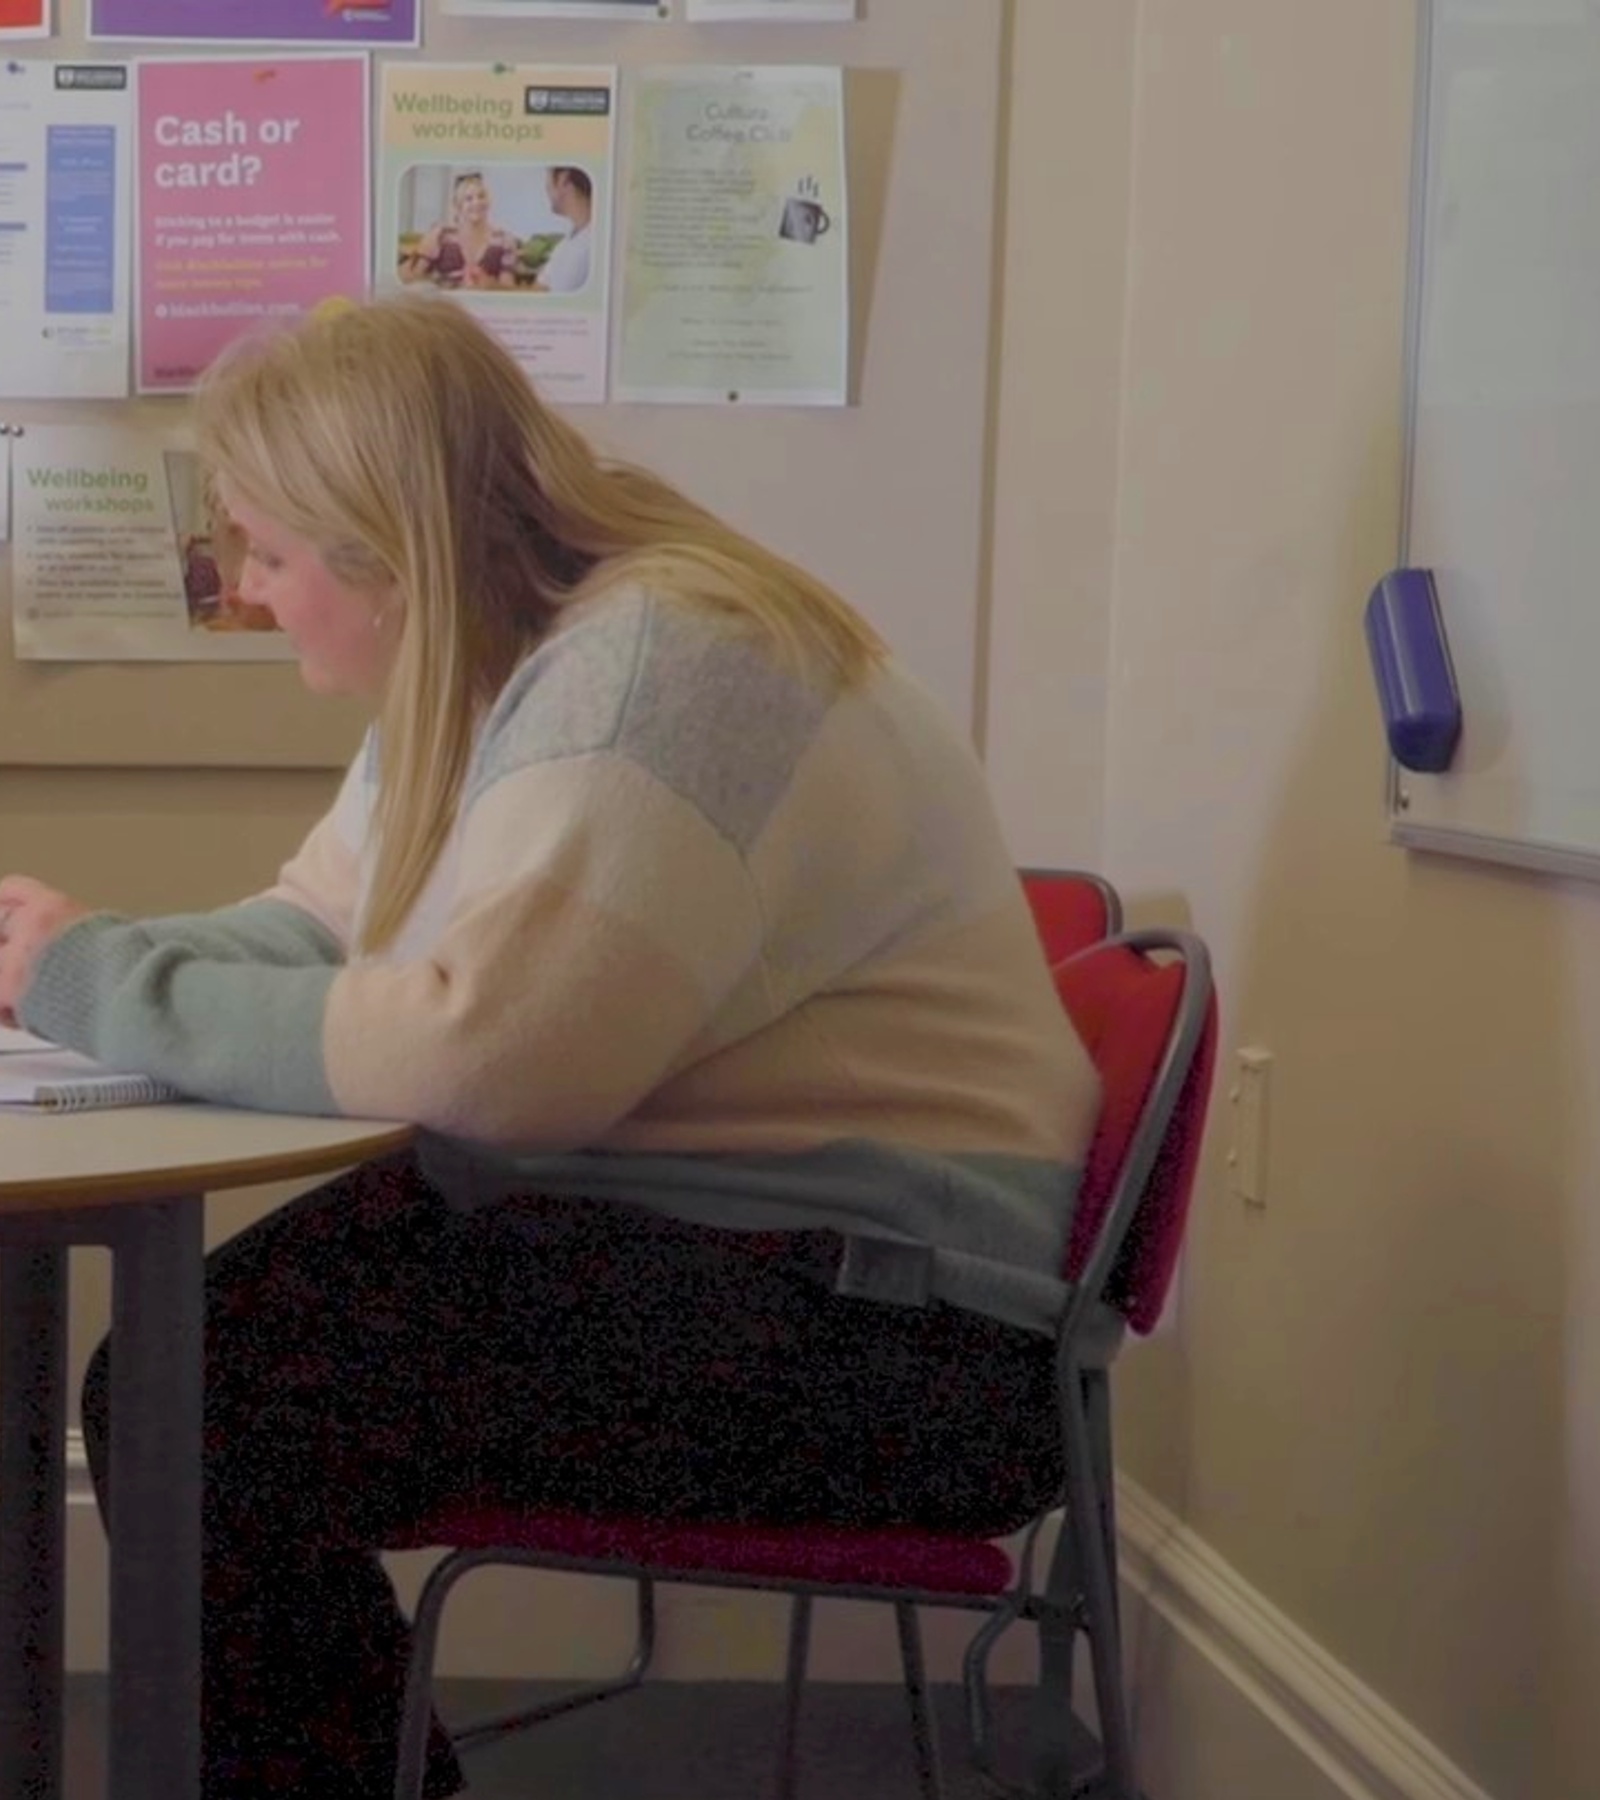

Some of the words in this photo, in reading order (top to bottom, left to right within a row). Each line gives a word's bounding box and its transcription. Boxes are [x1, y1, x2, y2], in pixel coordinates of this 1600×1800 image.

[393, 91, 513, 117] Wellbeing
[154, 110, 247, 146] Cash
[258, 117, 300, 143] or
[413, 118, 544, 141] workshops
[685, 124, 746, 144] Coffee
[154, 152, 263, 188] card?
[208, 216, 223, 228] to
[235, 213, 281, 229] budget
[297, 213, 336, 226] easier
[166, 235, 190, 249] you
[191, 235, 215, 249] pay
[217, 232, 236, 245] for
[278, 231, 307, 244] with
[27, 468, 149, 493] Wellbeing
[43, 497, 156, 515] workshops
